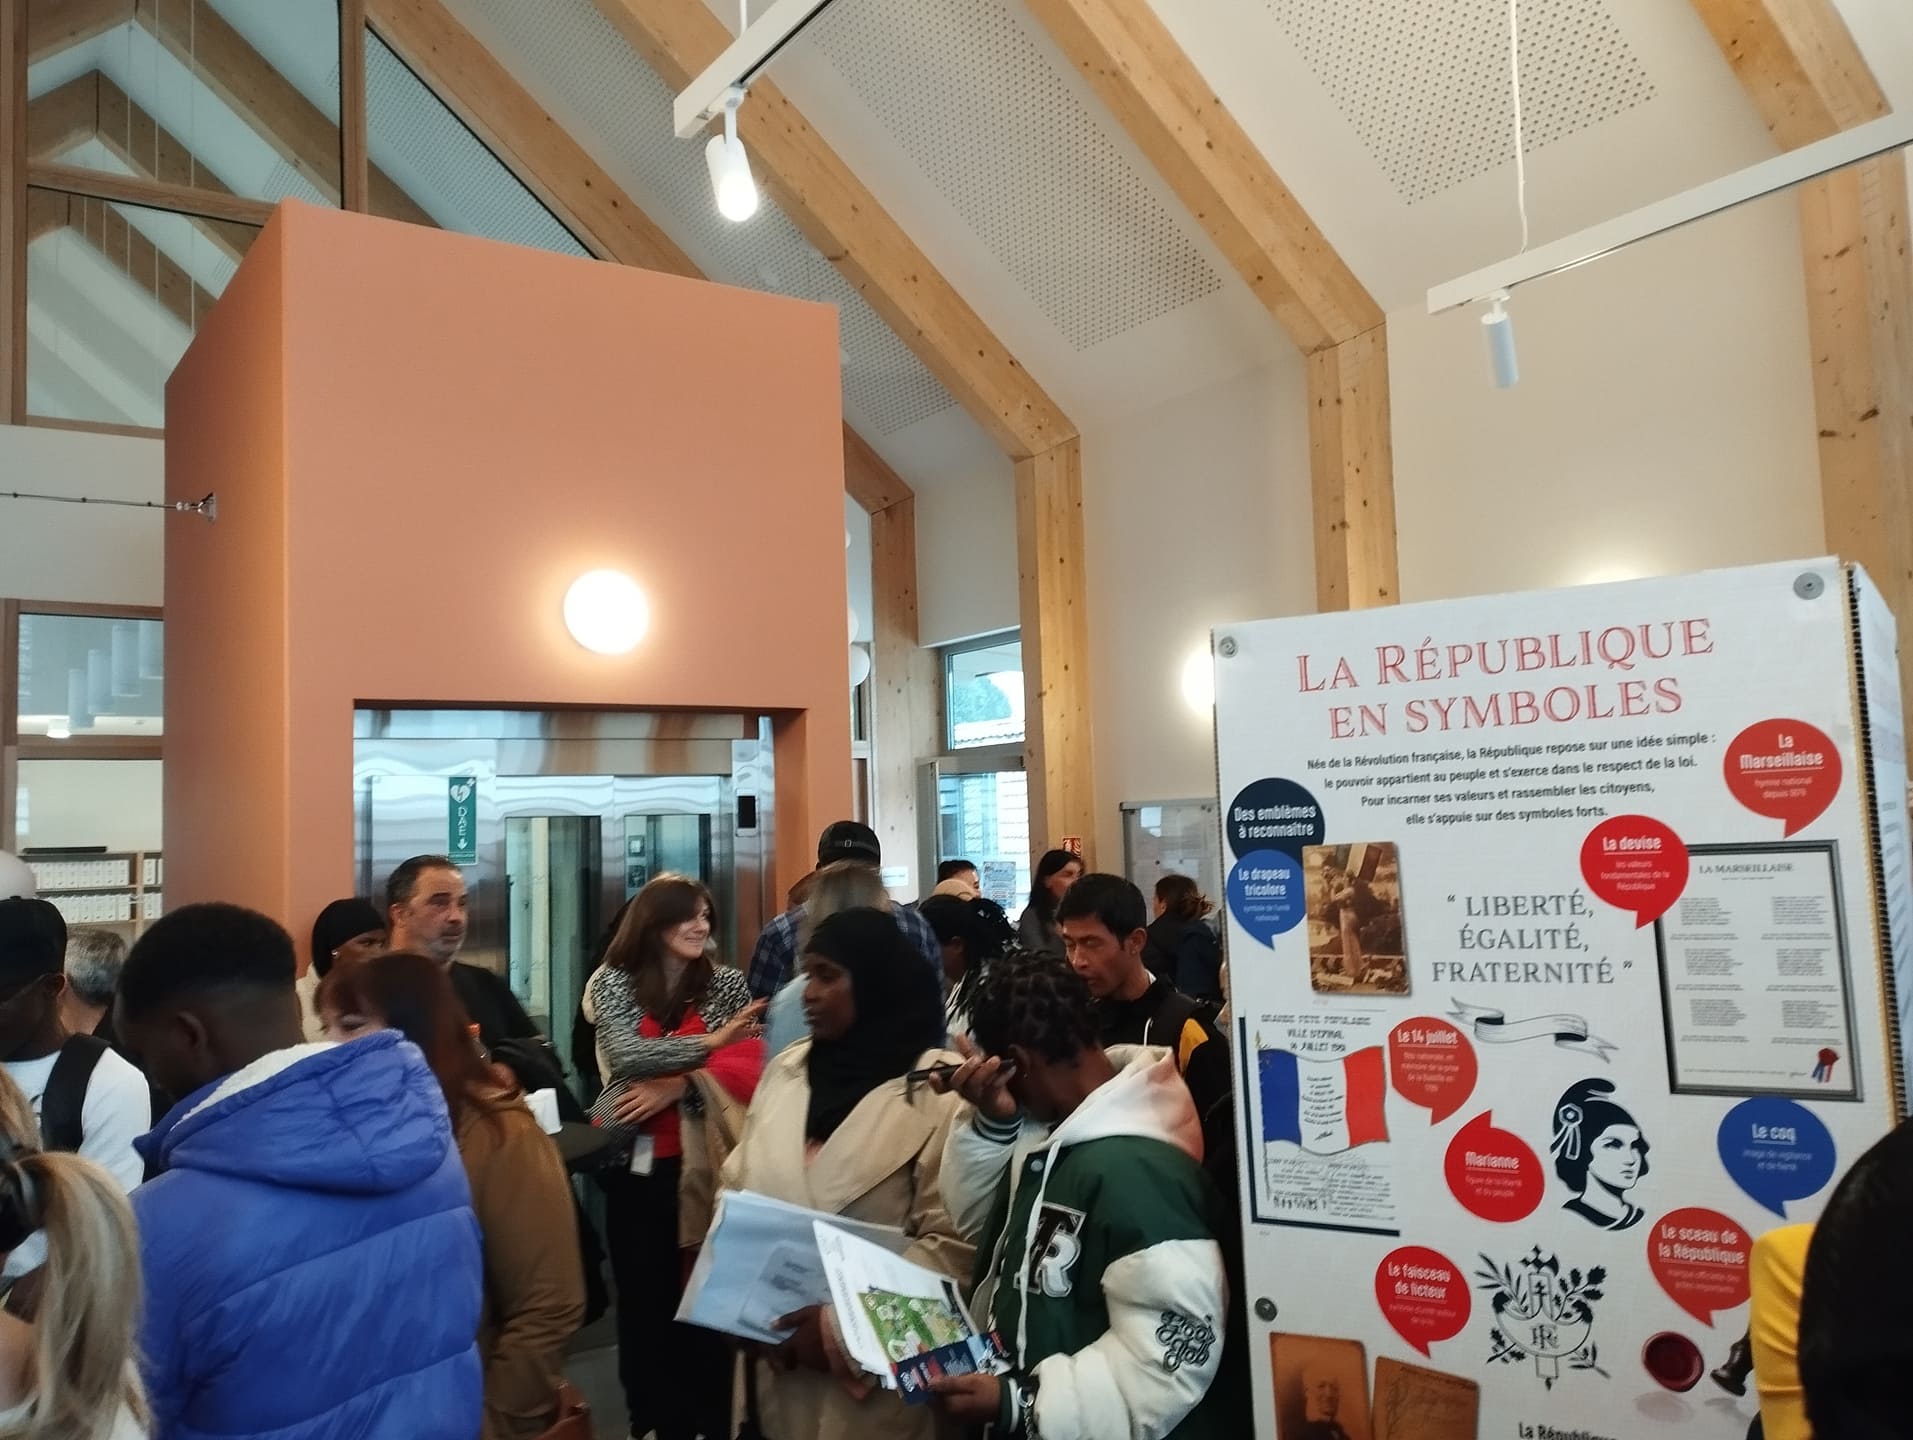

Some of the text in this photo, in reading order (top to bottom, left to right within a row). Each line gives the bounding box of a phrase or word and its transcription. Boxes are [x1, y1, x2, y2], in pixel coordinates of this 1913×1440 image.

[1296, 618, 1714, 693] LA RÉPUBLIQUE
[1329, 677, 1683, 740] EN SYMBOLES
[1307, 759, 1326, 770] Née
[1329, 758, 1341, 768] de
[1343, 757, 1353, 767] la
[1355, 752, 1409, 766] Révolution
[1411, 749, 1465, 764] française,
[1467, 748, 1477, 758] la
[1479, 743, 1543, 760] République
[1546, 742, 1586, 756] repose
[1589, 740, 1608, 751] sur
[1611, 739, 1633, 750] une
[1636, 734, 1663, 748] idée
[1666, 732, 1709, 748] simple
[1778, 733, 1794, 749] La
[1740, 751, 1824, 769] Marseillaise
[1324, 778, 1334, 789] le
[1336, 776, 1373, 790] pouvoir
[1376, 772, 1431, 788] appartient
[1433, 772, 1447, 782] au
[1450, 768, 1486, 783] peuple
[1489, 769, 1500, 779] et
[1552, 761, 1580, 775] dans
[1583, 761, 1593, 773] le
[1597, 759, 1643, 774] respect
[1645, 757, 1661, 770] de
[1664, 756, 1676, 769] la
[1678, 755, 1698, 768] loi.
[1361, 781, 1656, 807] Pour incarner ses valeurs et rassembler les citoyens,
[1234, 804, 1317, 822] Des emblèmes
[1406, 813, 1425, 825] elle
[1475, 811, 1493, 822] sur
[1495, 808, 1516, 821] des
[1518, 806, 1575, 823] symboles
[1576, 805, 1609, 818] forts.
[1238, 821, 1315, 839] à reconnaître
[1602, 835, 1662, 851] La devise
[1238, 867, 1291, 882] Le drapeau
[1244, 883, 1287, 897] tricolore
[1465, 888, 1594, 918] LIBERTÉ,
[1458, 921, 1589, 952] ÉGALITÉ,
[1431, 956, 1615, 984] FRATERNITÉ
[1397, 1028, 1459, 1045] Le 14 juillet
[1752, 1123, 1797, 1143] Le coq
[1465, 1150, 1520, 1169] Marianne
[1661, 1223, 1738, 1245] Le sceau de
[1658, 1242, 1746, 1265] la République
[1387, 1261, 1451, 1282] Le faisceau
[1394, 1280, 1447, 1299] de licteur
